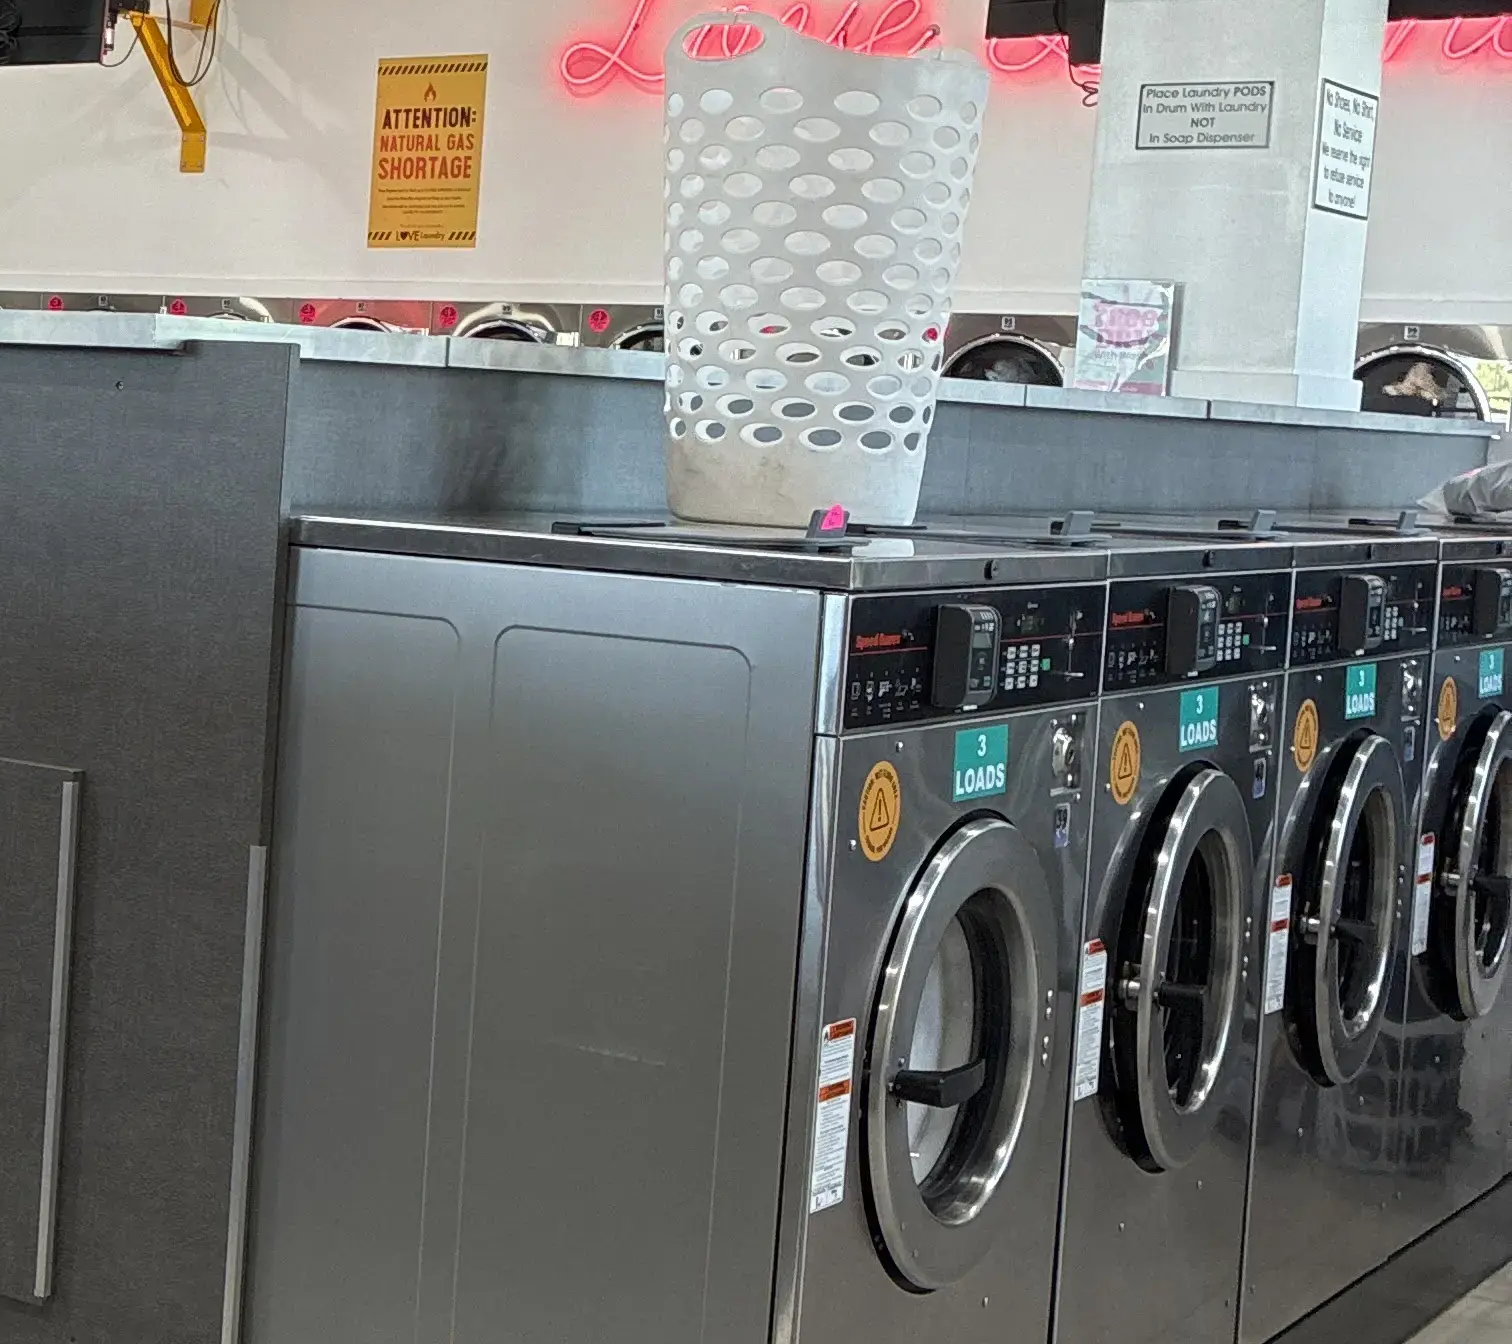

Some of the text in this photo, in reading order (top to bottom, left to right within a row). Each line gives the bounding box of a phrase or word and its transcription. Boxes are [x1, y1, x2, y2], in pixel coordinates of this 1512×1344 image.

[1146, 85, 1267, 101] Place Laundry PODS
[1143, 101, 1267, 114] In Drum With Laundry
[382, 106, 477, 130] ATTENTION:
[1190, 117, 1216, 128] NOT
[380, 133, 475, 152] NATURAL GAS
[1149, 132, 1255, 144] In Soap Dispenser
[377, 156, 472, 180] SHORTAGE
[1358, 669, 1364, 687] 3
[1196, 694, 1203, 714] 3
[1346, 692, 1375, 716] LOADS
[1180, 719, 1217, 747] LOADS
[977, 734, 987, 756] 3
[955, 763, 1005, 795] LOADS
